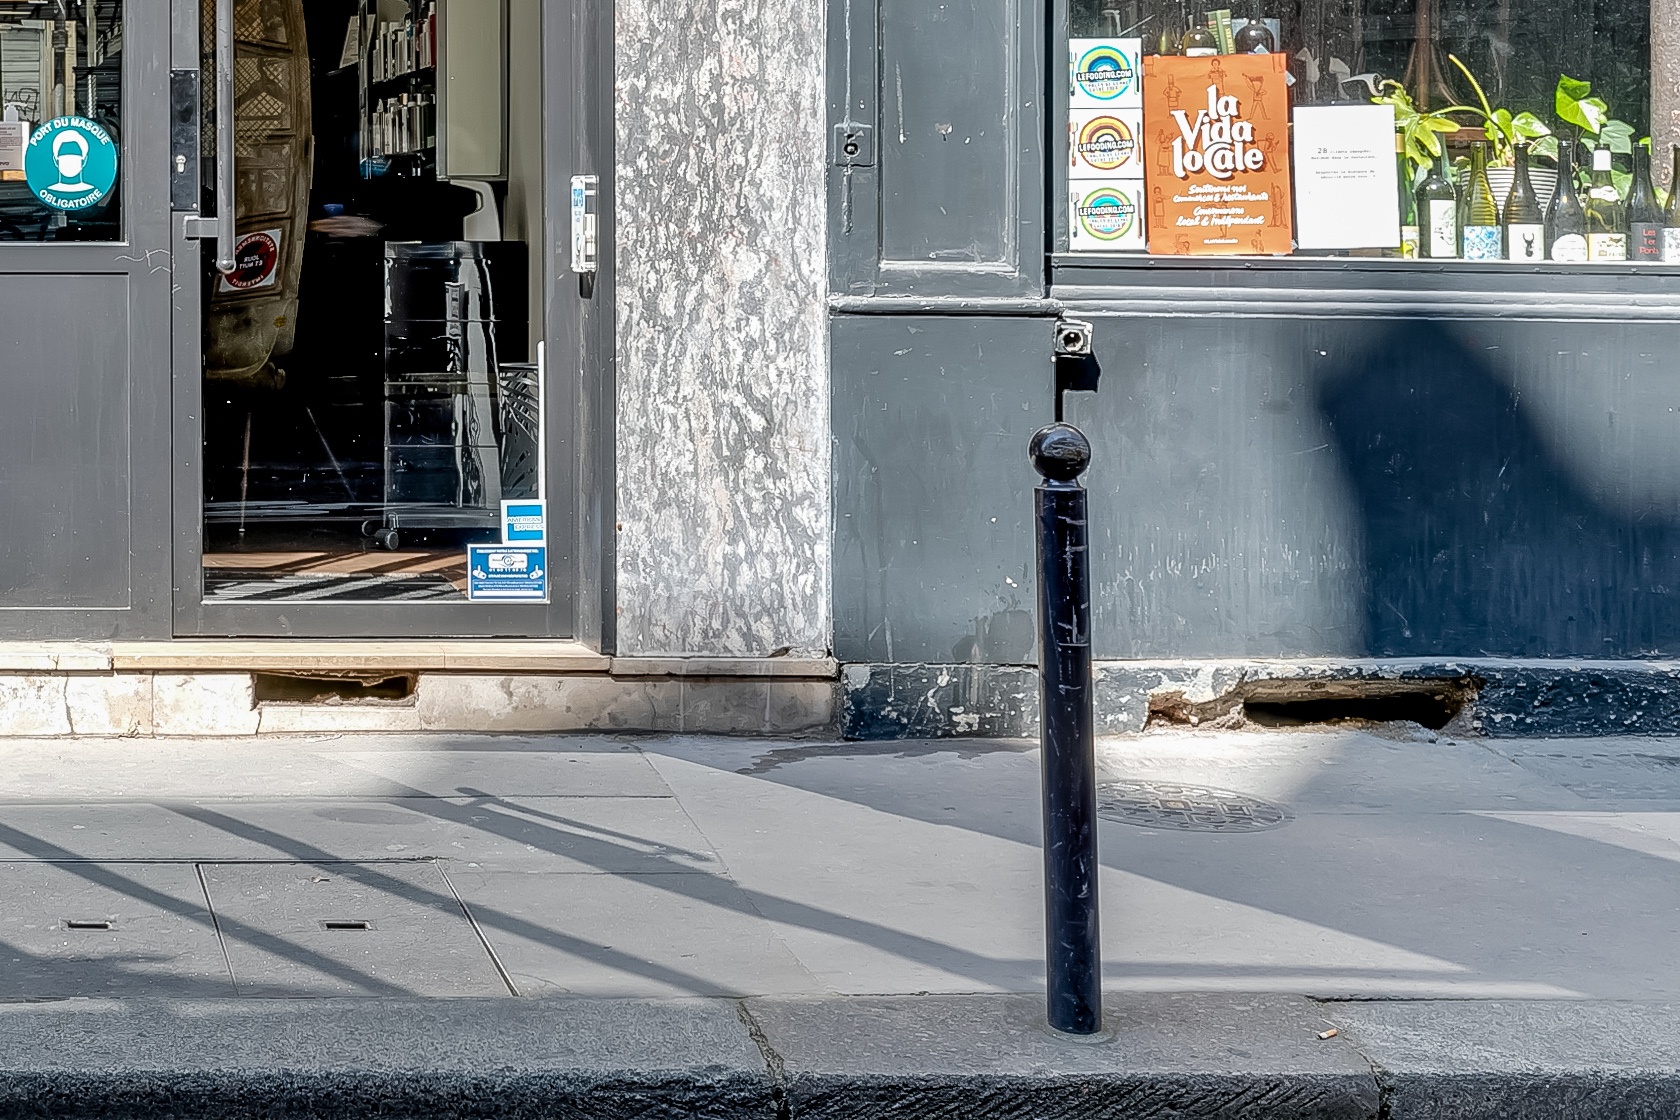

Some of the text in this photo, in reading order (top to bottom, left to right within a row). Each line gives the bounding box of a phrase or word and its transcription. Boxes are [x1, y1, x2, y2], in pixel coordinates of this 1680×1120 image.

[29, 122, 53, 147] PORT
[53, 117, 69, 129] DU
[70, 117, 110, 146] MASQUE
[1170, 109, 1254, 151] Vida
[39, 188, 103, 208] OBLIGATOIRE
